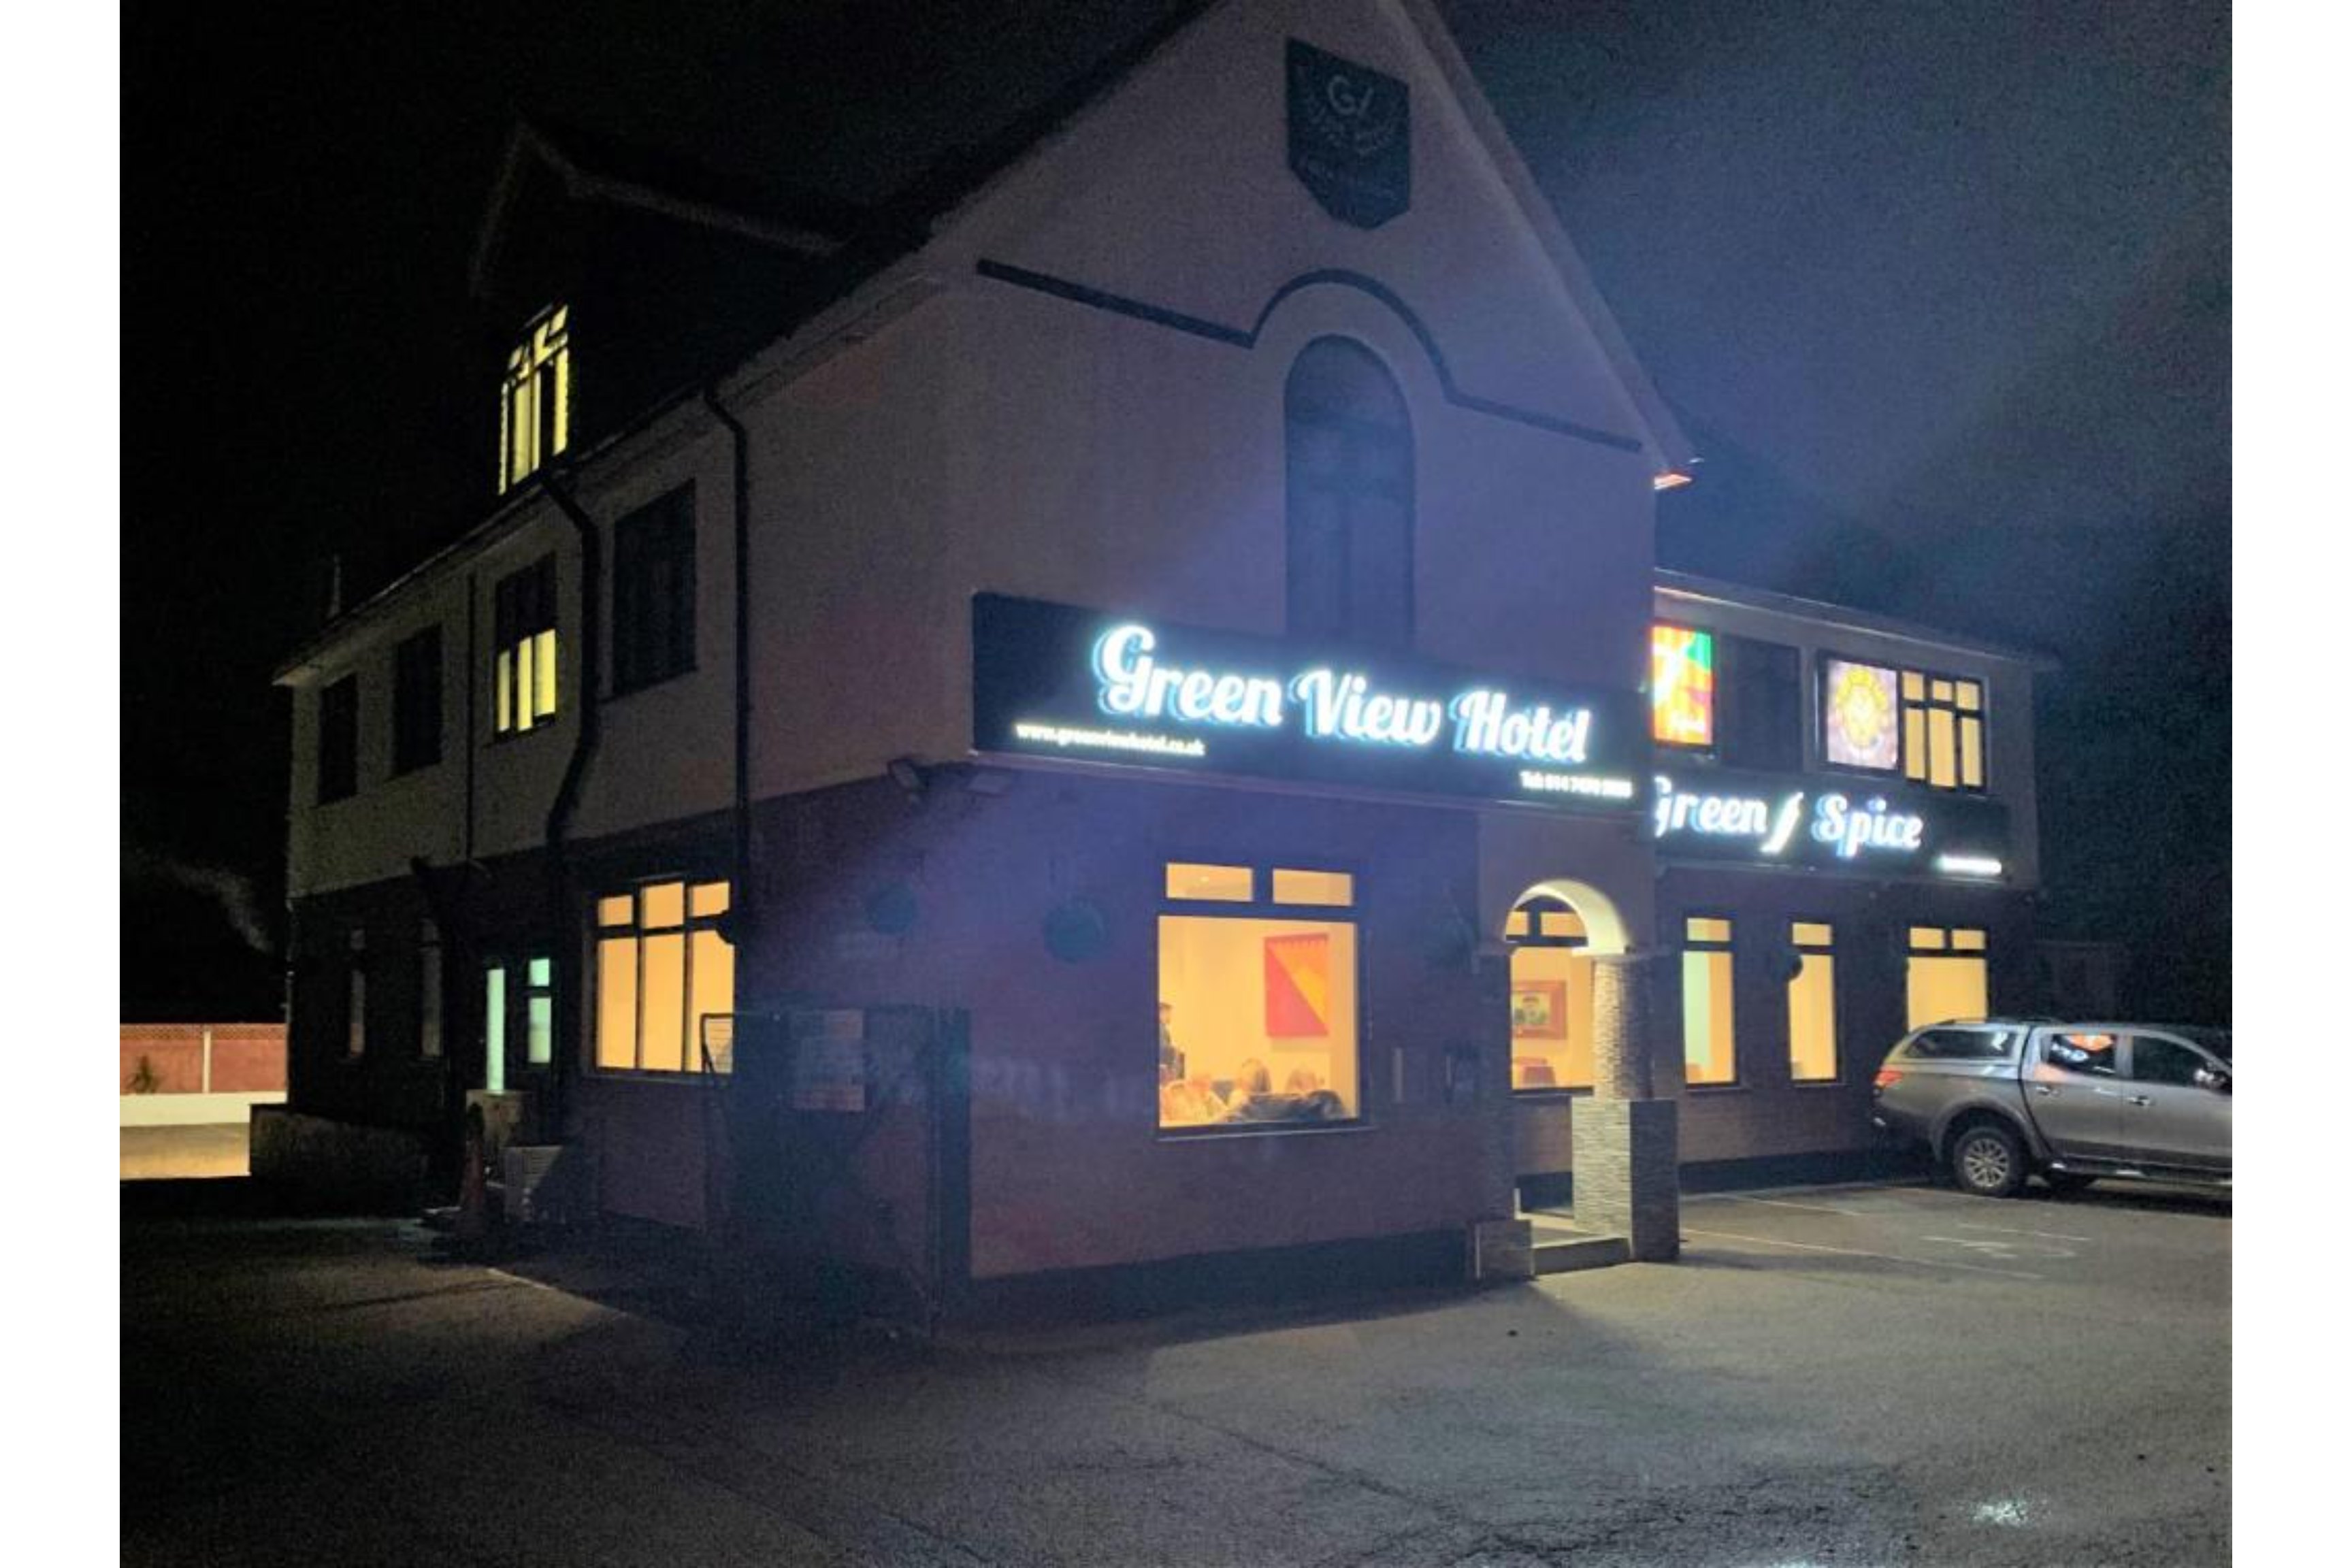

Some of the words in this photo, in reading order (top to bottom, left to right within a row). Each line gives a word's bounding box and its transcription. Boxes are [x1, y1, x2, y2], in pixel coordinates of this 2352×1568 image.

[1094, 624, 1284, 728] Green
[1291, 668, 1443, 747] View
[1451, 686, 1591, 765] Hotel
[1811, 794, 1923, 858] Spice
